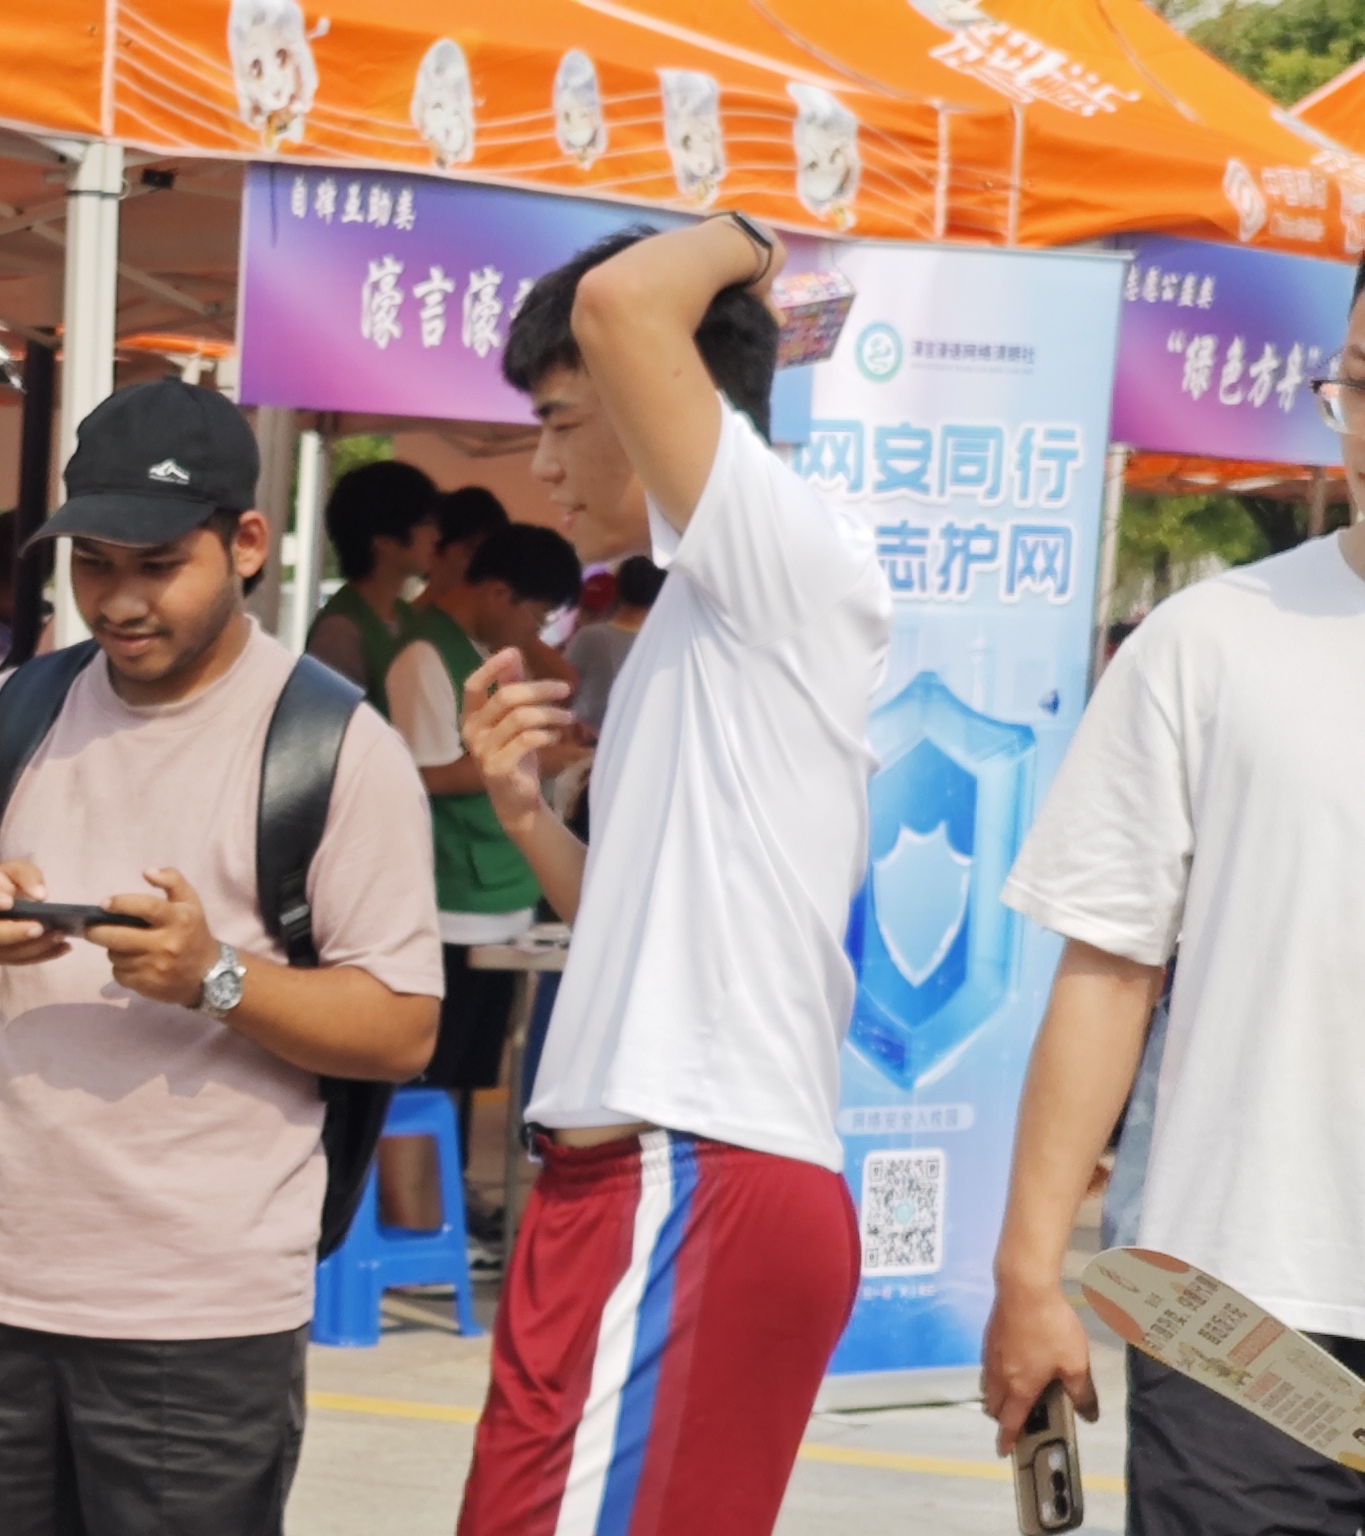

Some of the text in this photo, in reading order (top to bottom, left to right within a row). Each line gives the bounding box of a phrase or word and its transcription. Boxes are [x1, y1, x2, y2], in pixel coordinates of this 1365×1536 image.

[1166, 330, 1341, 413] “绿色方舟”
[794, 418, 1081, 505] 网安同行
